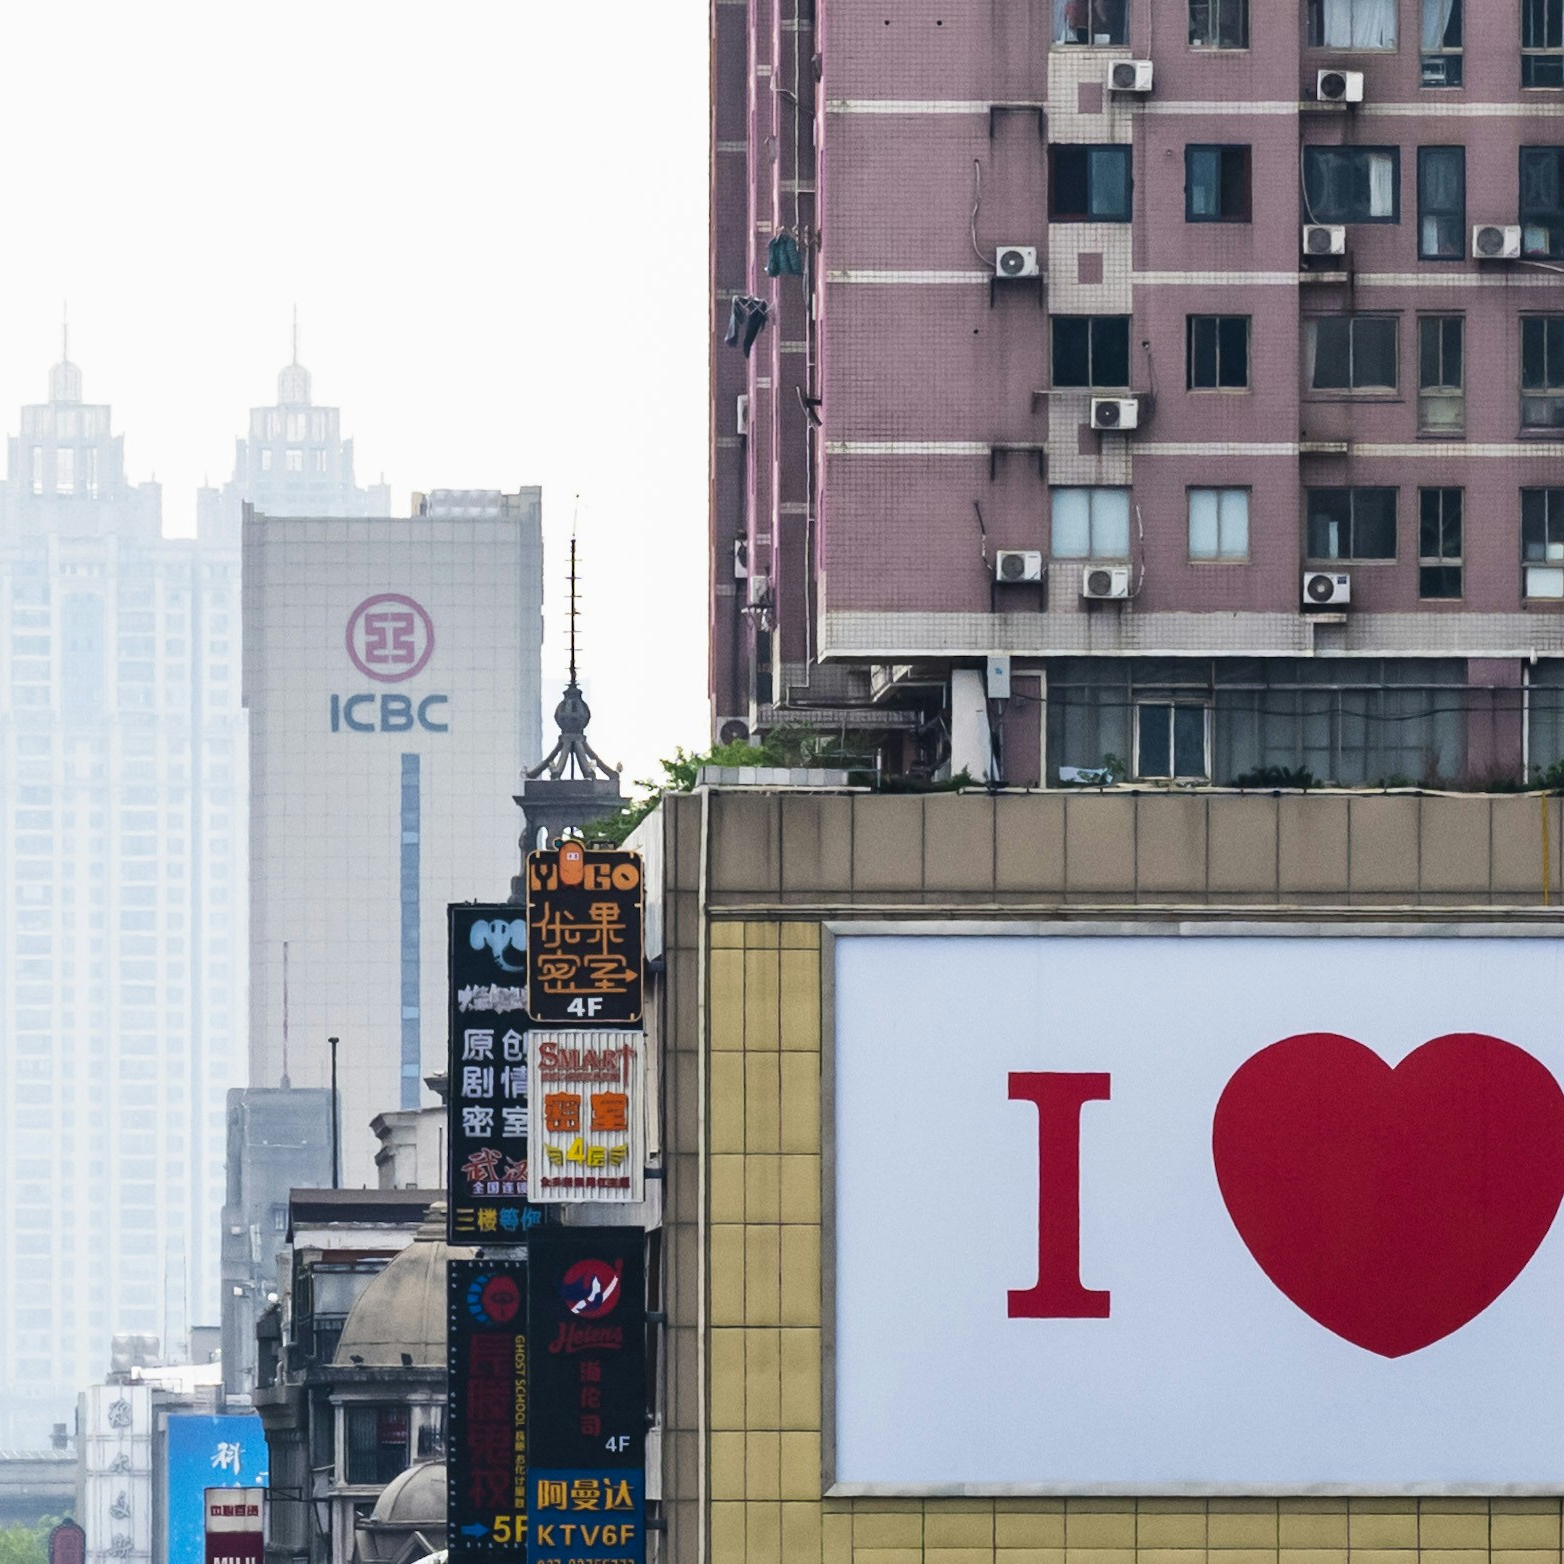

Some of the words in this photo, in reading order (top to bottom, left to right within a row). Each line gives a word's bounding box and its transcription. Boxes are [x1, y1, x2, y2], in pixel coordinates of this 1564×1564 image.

[330, 694, 448, 733] ICBC
[567, 998, 602, 1017] 4F
[462, 1106, 528, 1138] 密室
[1008, 1071, 1111, 1318] I
[515, 1335, 526, 1375] GHOST
[515, 1379, 526, 1425] SCHOOL
[605, 1435, 630, 1453] 4F
[538, 1478, 635, 1511] 阿曼达
[493, 1515, 528, 1543] 5F
[538, 1524, 635, 1547] KTV6F
